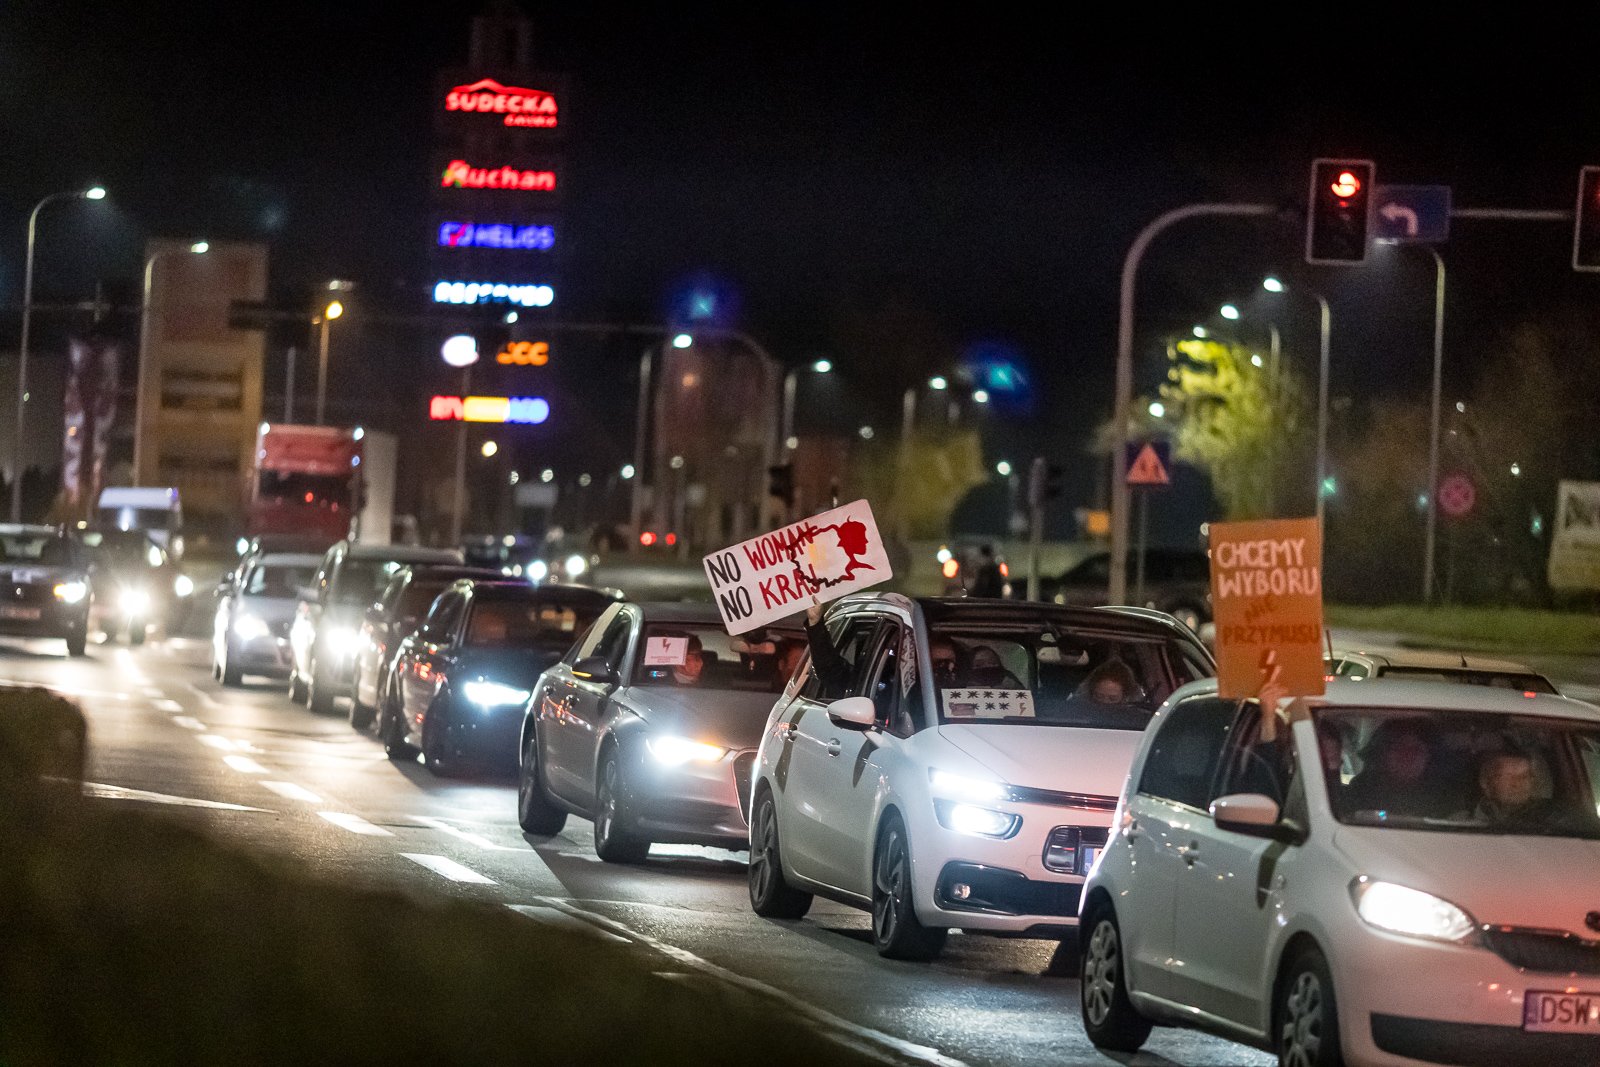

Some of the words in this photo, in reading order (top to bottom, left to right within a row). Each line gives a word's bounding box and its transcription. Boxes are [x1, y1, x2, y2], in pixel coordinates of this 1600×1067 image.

[446, 92, 558, 115] SUDECKA
[706, 552, 742, 588] NO
[743, 522, 817, 571] WOMAN
[1216, 537, 1306, 568] CHCEMY
[720, 585, 753, 622] NO
[759, 563, 821, 609] KRAJ
[1218, 567, 1319, 599] WYBORU
[1541, 996, 1591, 1024] DSW
